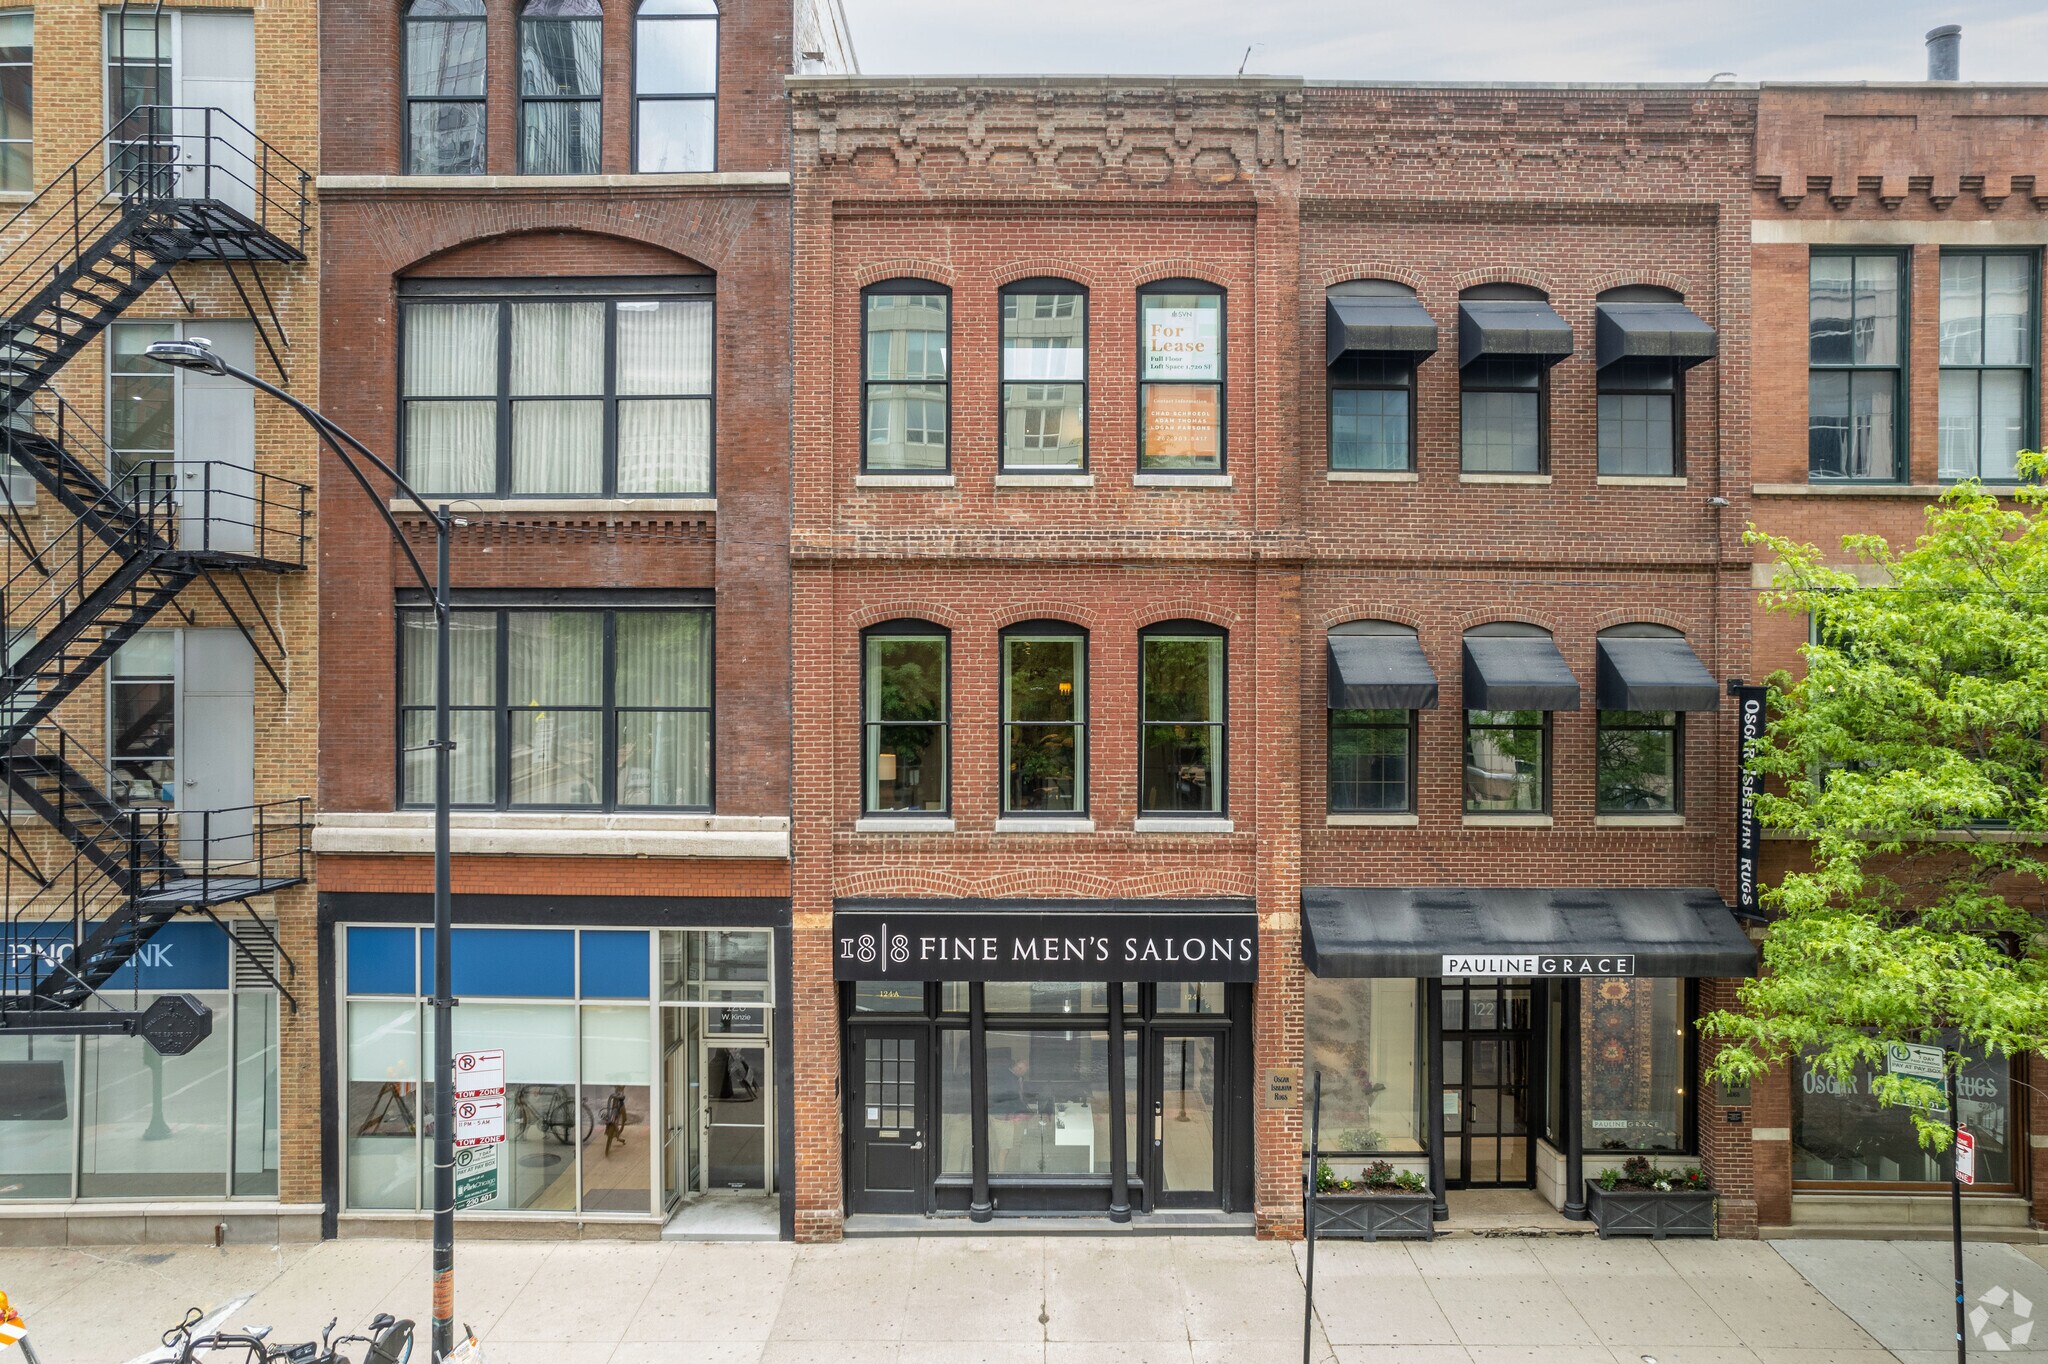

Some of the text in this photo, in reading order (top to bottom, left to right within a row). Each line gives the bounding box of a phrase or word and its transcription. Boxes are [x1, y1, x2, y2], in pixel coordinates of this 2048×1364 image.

[1151, 324, 1184, 337] For
[1151, 339, 1204, 352] Lease
[1741, 858, 1752, 905] RUGS
[920, 937, 998, 960] FINE
[1012, 937, 1110, 960] MEN'S
[1124, 938, 1252, 961] SALONS
[1450, 959, 1626, 972] PAULINE GRACE
[1473, 1003, 1494, 1016] 122
[1956, 1171, 1968, 1180] ONE
[466, 1198, 479, 1207] 230
